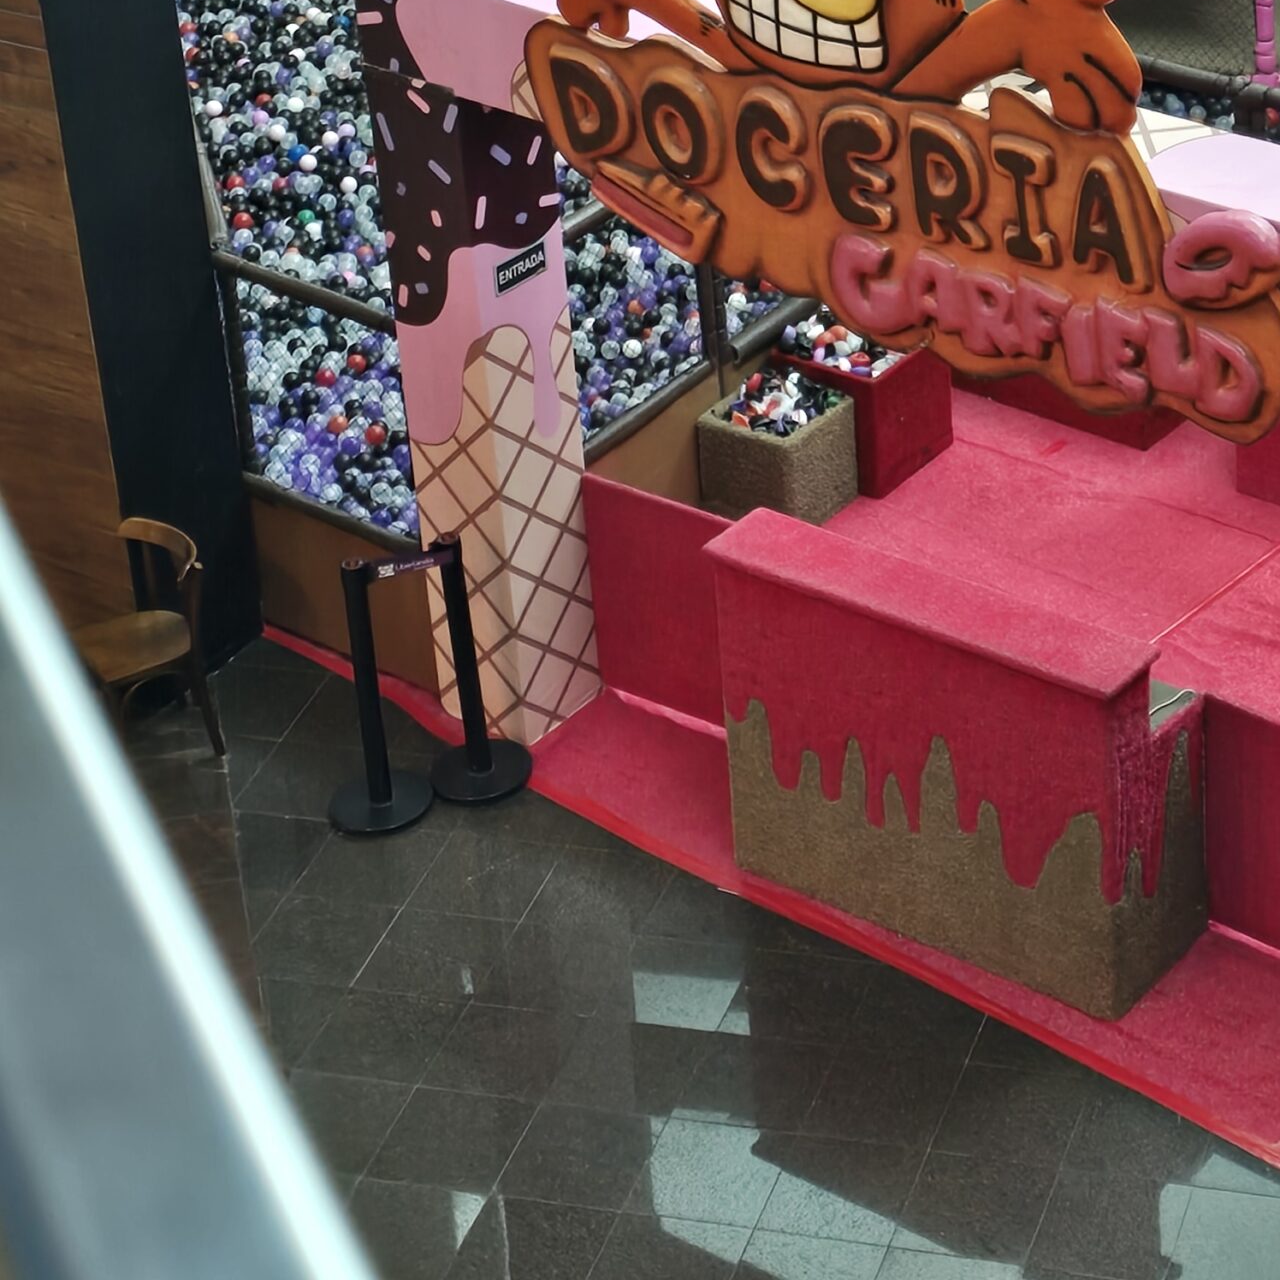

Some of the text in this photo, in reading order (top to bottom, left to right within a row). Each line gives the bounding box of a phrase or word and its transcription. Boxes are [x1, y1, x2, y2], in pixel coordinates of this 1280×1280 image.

[549, 41, 1153, 294] DOCERIA
[498, 250, 545, 285] ENTRADA
[831, 233, 1264, 419] GARFIELD
